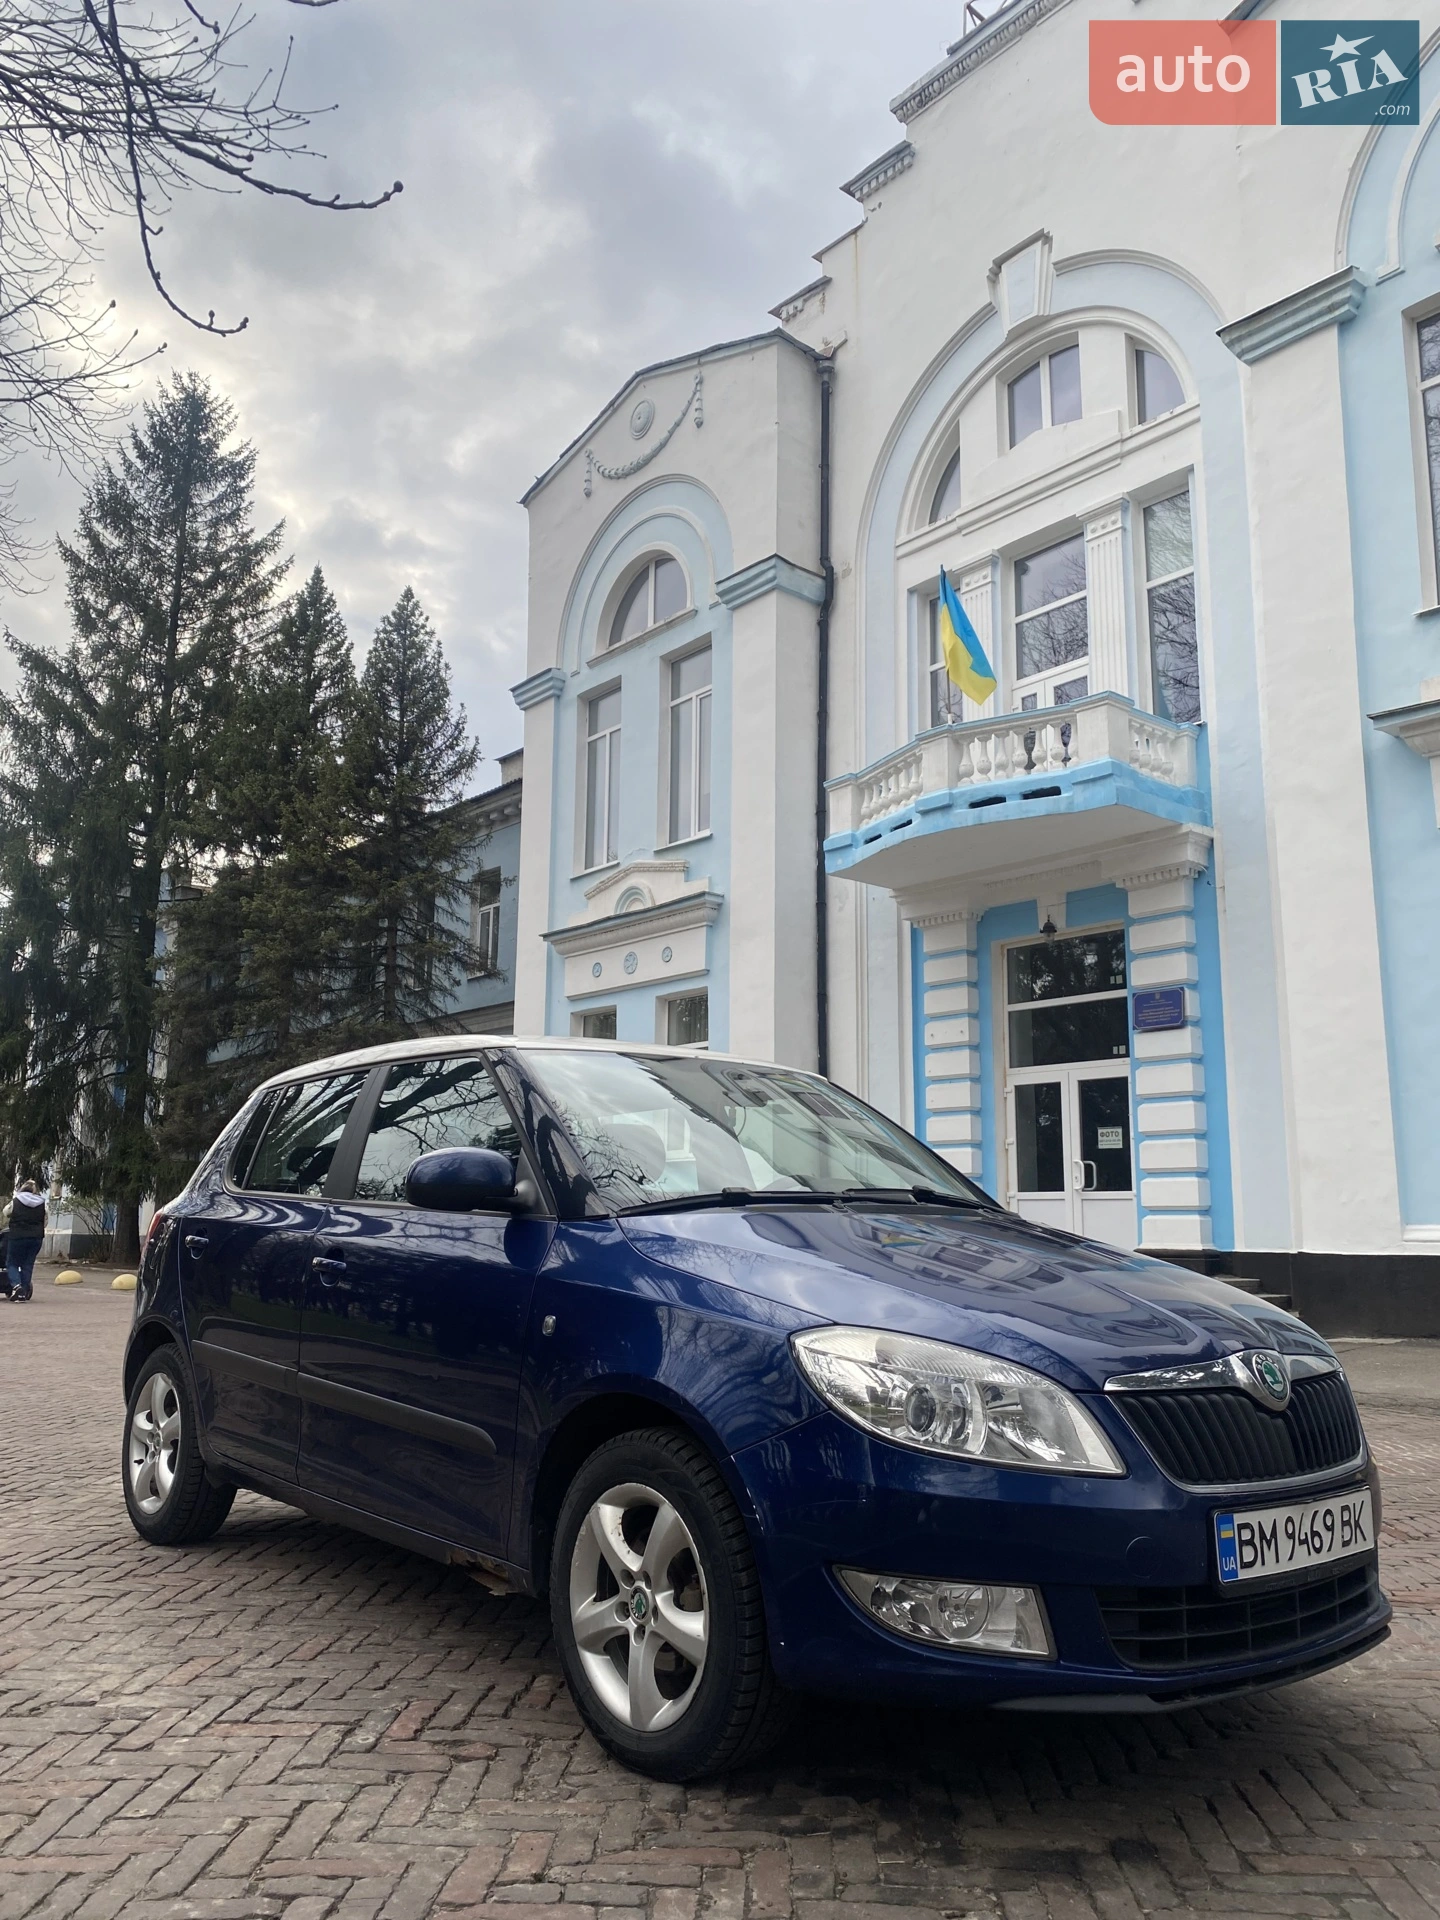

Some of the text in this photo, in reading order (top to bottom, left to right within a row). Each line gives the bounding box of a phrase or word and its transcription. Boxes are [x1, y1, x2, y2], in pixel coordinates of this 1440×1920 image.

[1099, 1130, 1120, 1138] ФОТО
[1237, 1500, 1367, 1569] BM 9469 BK
[1222, 1556, 1237, 1571] UA
